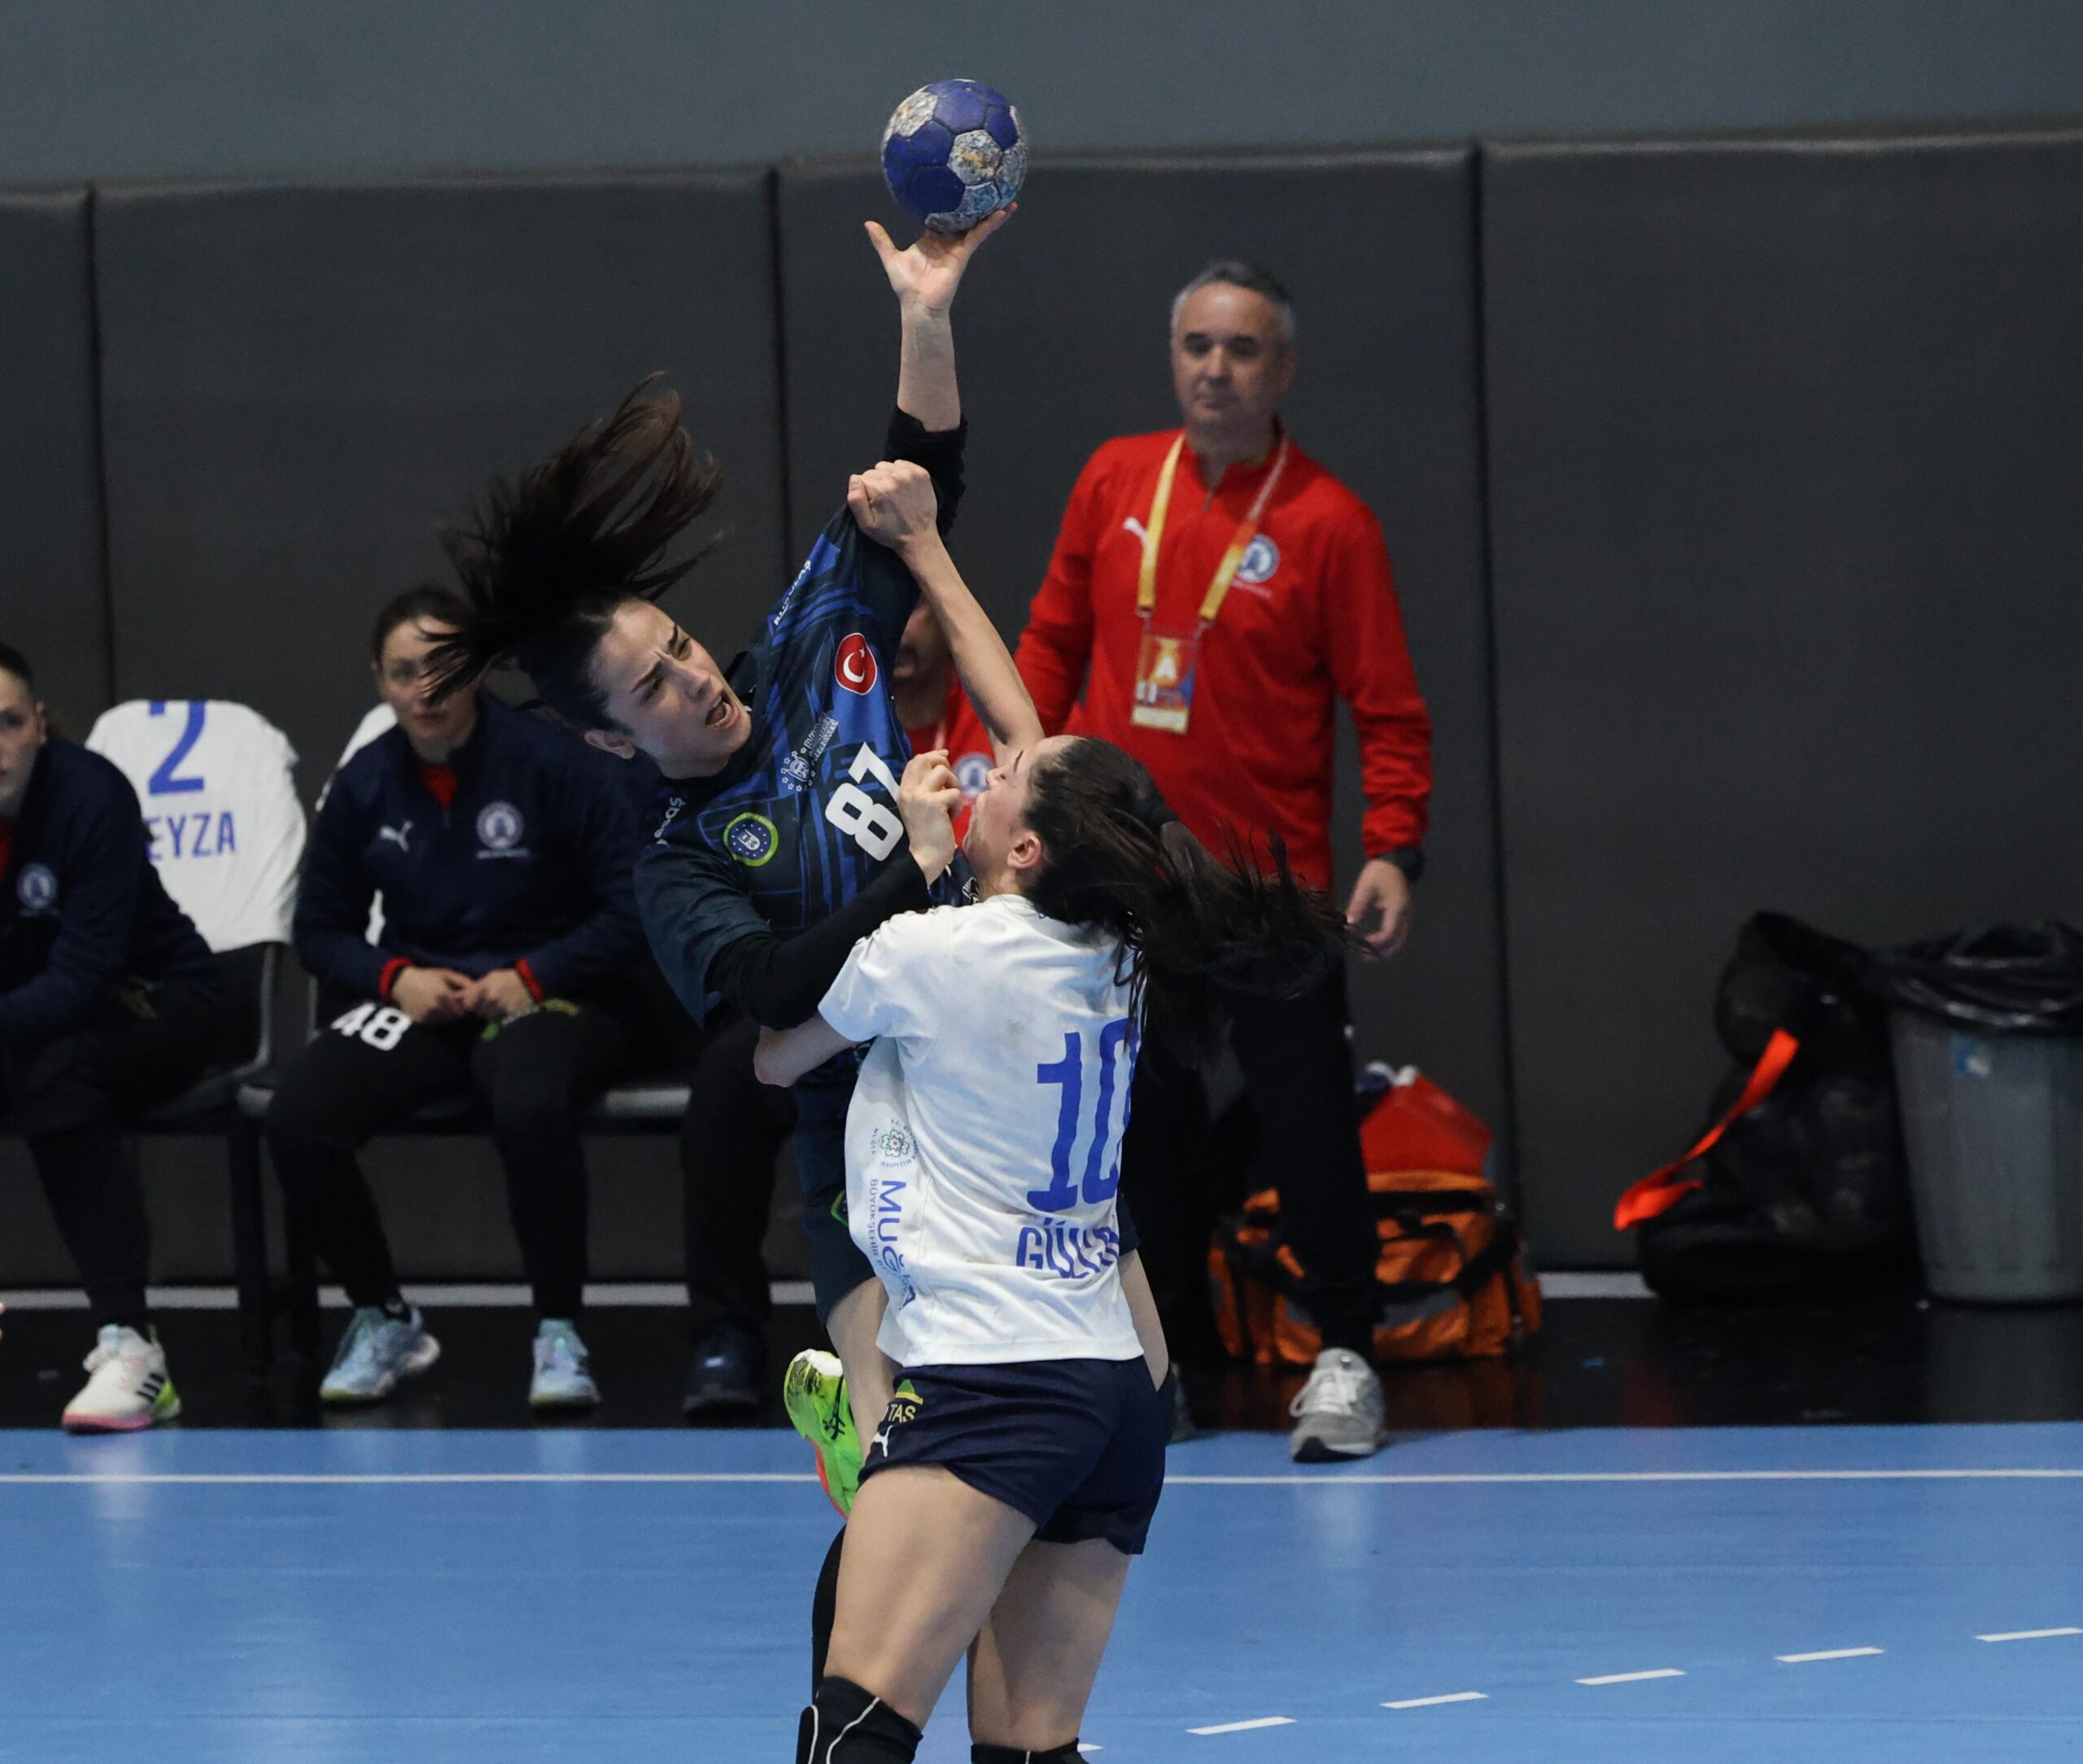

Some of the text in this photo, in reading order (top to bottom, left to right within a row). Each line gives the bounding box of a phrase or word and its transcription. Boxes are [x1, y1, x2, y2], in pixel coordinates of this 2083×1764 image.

[148, 700, 206, 795] 2
[825, 741, 903, 862] 87
[1027, 1017, 1140, 1212] 10
